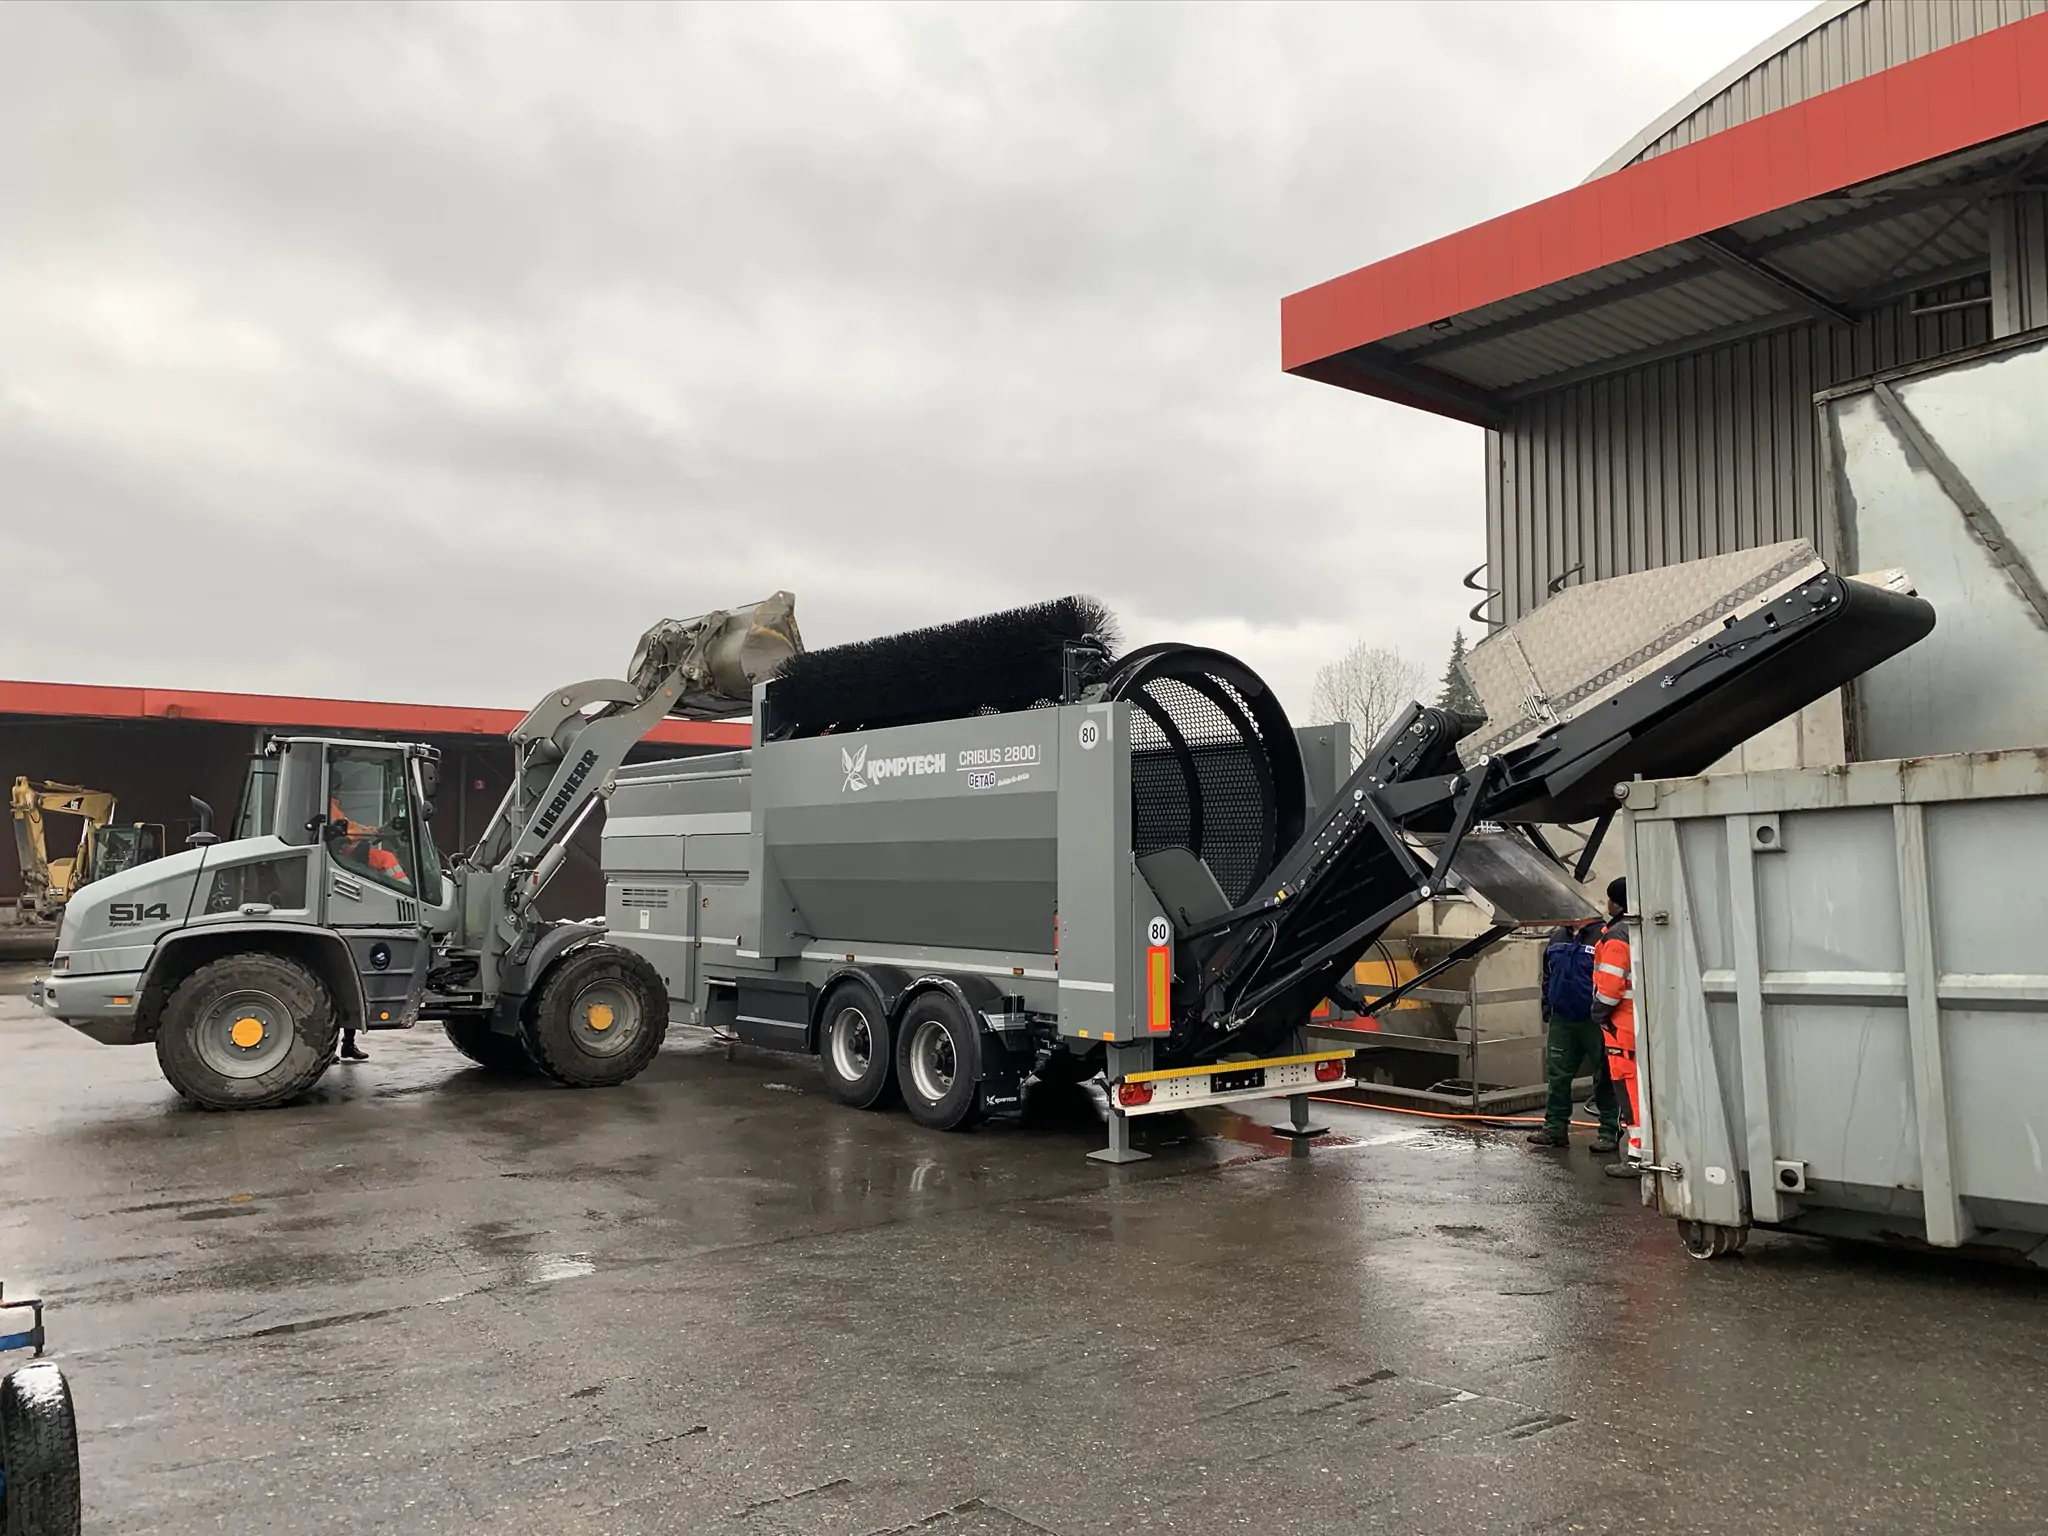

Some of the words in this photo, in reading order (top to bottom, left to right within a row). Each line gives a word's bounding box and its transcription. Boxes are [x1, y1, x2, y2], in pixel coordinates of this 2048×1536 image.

[1082, 727, 1096, 743] 80
[959, 748, 1001, 765] CRIBUS
[1004, 745, 1036, 762] 2800
[867, 753, 946, 785] KOMPTECH
[968, 771, 995, 789] GETAG
[532, 749, 600, 839] LIEBHERR
[109, 903, 171, 921] 514
[1152, 924, 1166, 940] 80
